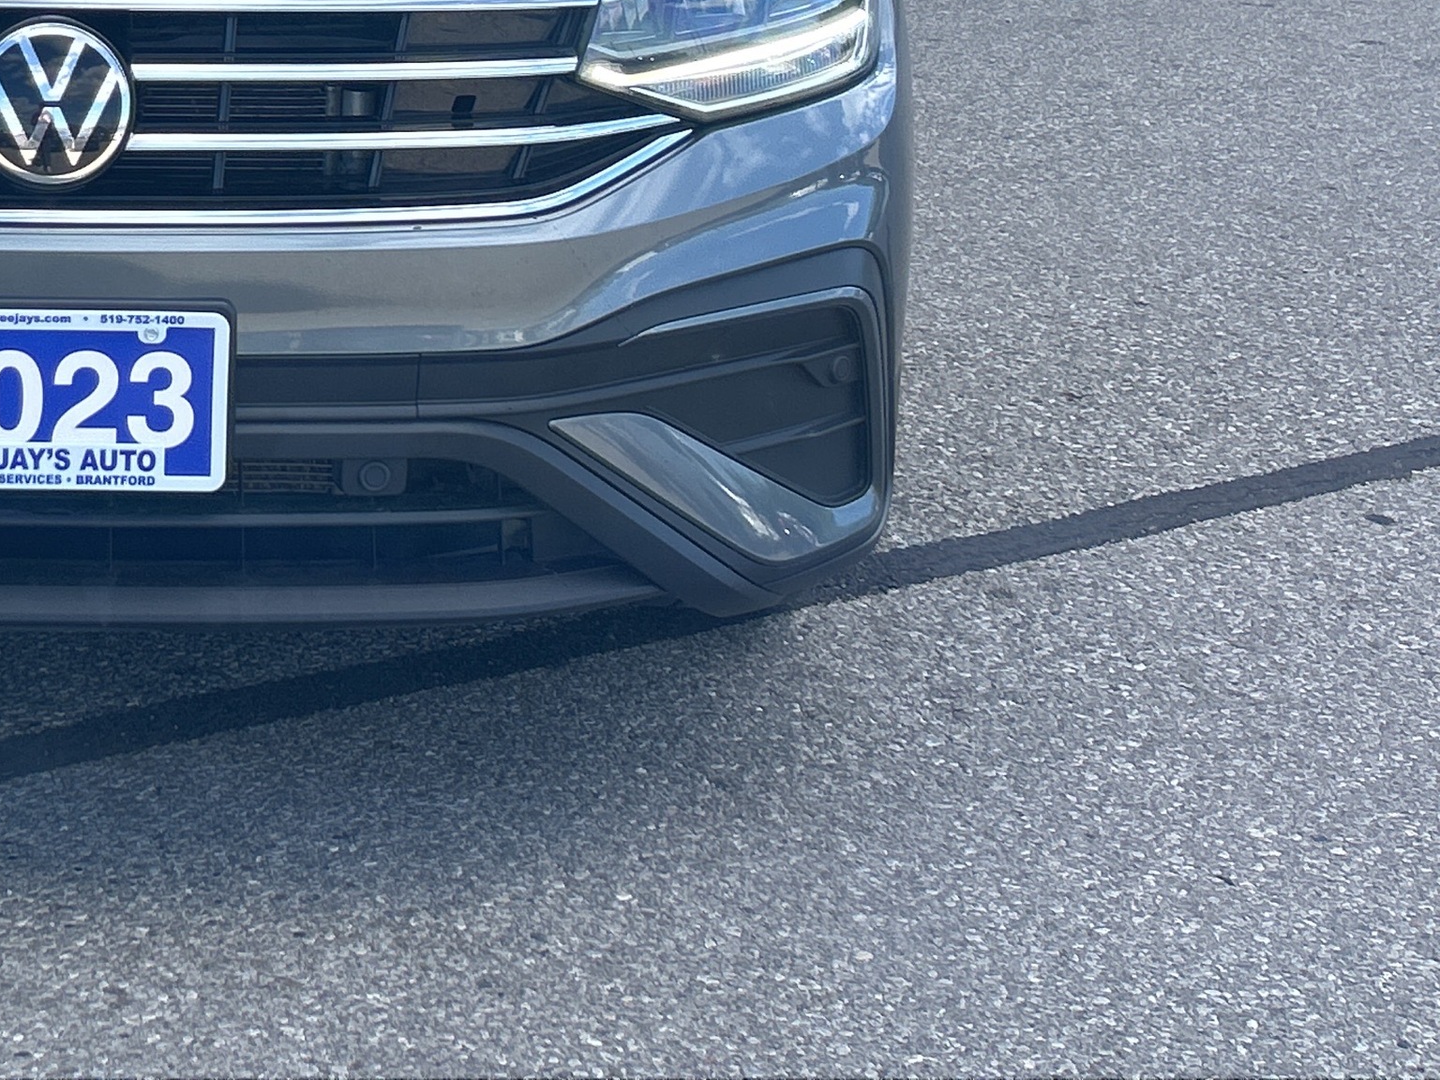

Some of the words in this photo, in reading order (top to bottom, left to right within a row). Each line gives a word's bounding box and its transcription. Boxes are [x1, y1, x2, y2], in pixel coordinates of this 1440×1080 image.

[100, 314, 185, 326] 519-752-1400
[80, 449, 156, 472] AUTO
[75, 474, 156, 486] BRANTFORD
